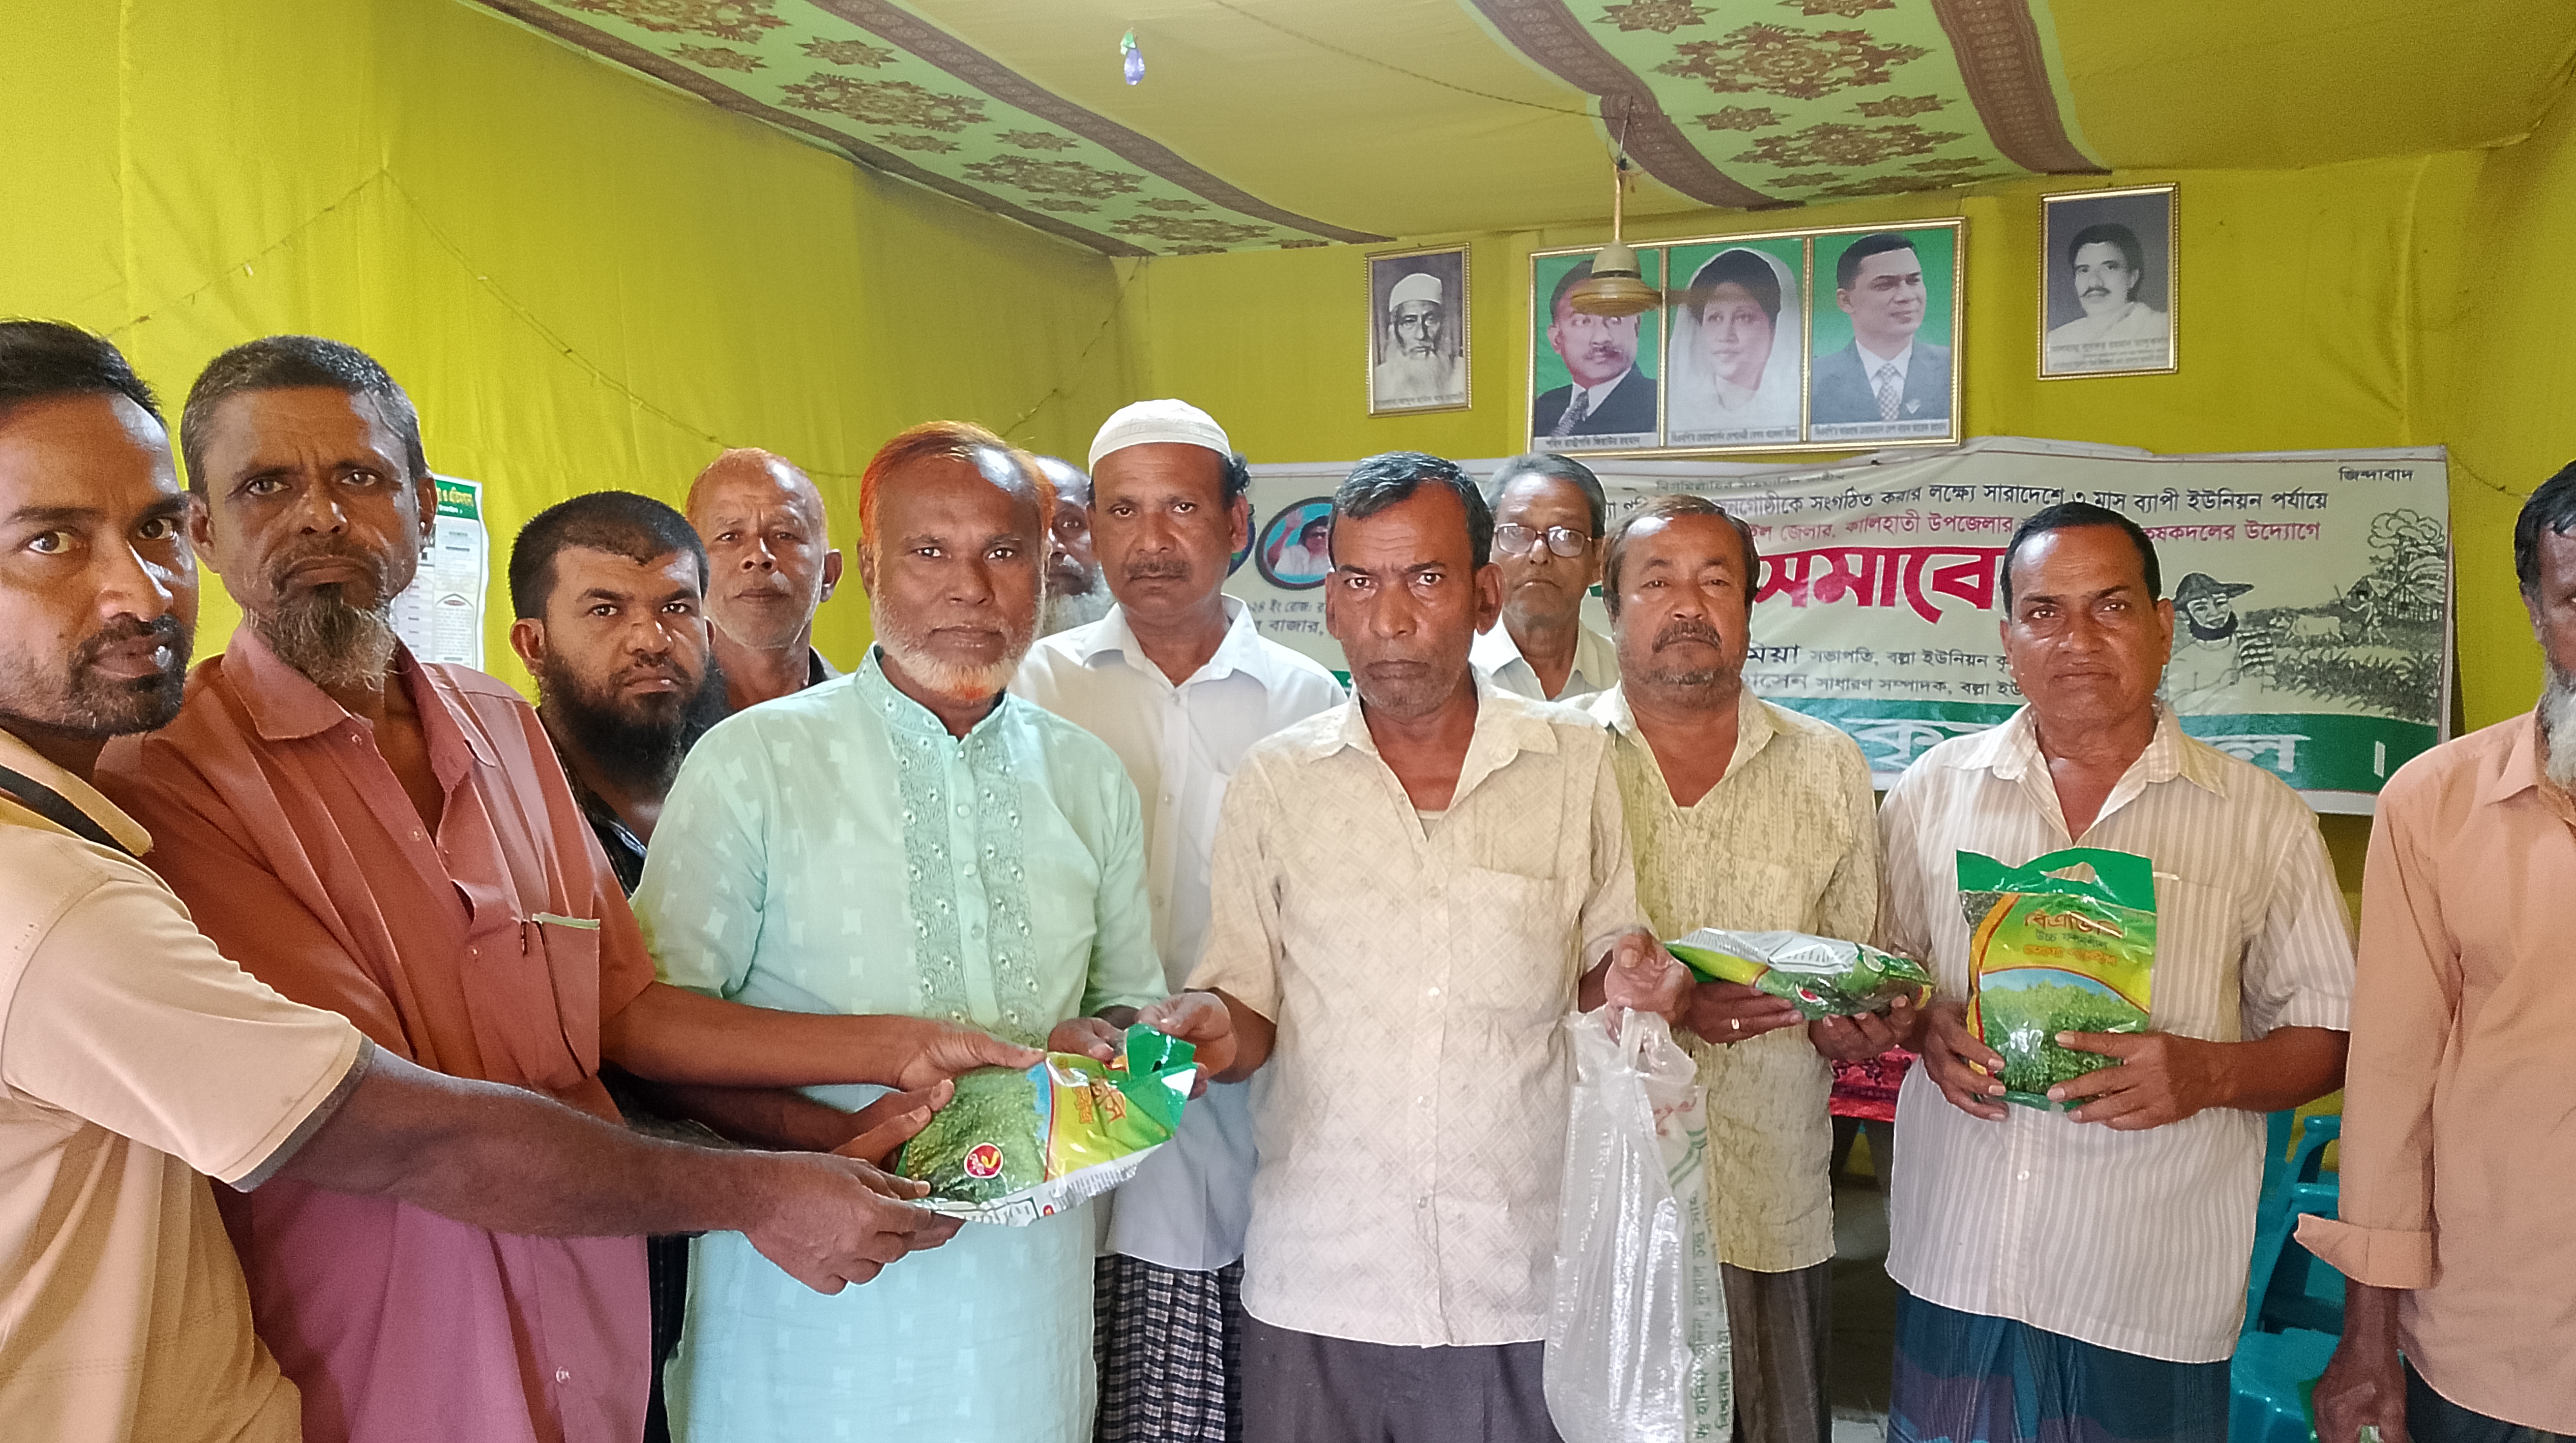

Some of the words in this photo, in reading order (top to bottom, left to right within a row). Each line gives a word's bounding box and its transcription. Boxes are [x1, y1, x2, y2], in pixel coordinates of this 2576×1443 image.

[2338, 466, 2414, 482] জিন্দাবাদ
[1712, 490, 1804, 516] নগোষ্ঠীকে
[1810, 486, 1875, 511] সংগঠিত
[1880, 486, 1922, 504] করার
[1929, 484, 1976, 503] লক্ষ্যে
[1983, 484, 2065, 505] সারাদেশে
[2093, 491, 2126, 511] মাস
[2132, 487, 2179, 513] ব্যাপী
[2186, 487, 2262, 513] ইউনিয়ন
[2271, 486, 2328, 510] পর্যায়ে
[1845, 508, 1920, 535] কালিহাতী
[1927, 511, 2014, 534] উপজেলার
[2244, 519, 2321, 541] উদ্যোগে
[1754, 546, 2008, 624] সমাবে
[1922, 649, 1989, 667] ইউনিয়ন
[1816, 677, 1873, 691] সাধারণ
